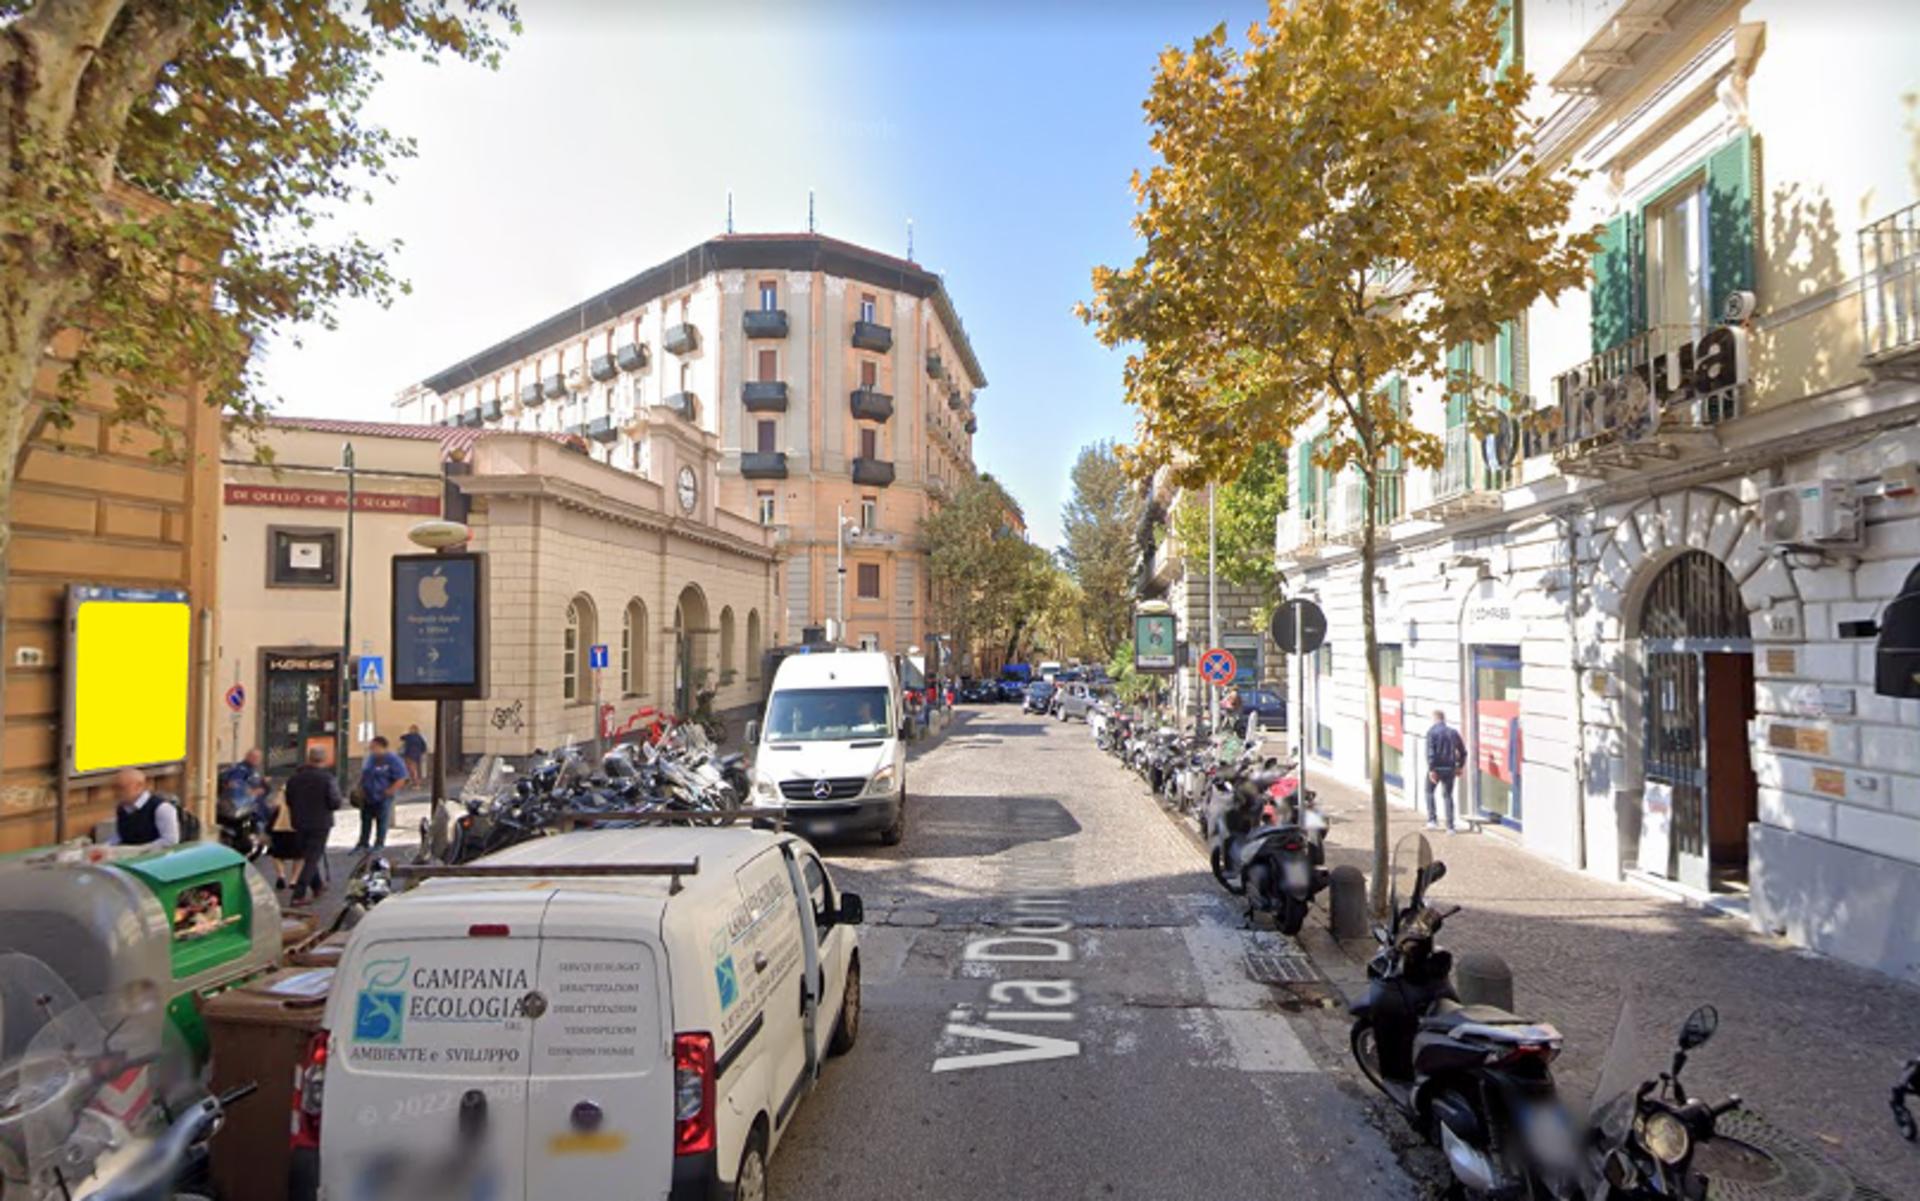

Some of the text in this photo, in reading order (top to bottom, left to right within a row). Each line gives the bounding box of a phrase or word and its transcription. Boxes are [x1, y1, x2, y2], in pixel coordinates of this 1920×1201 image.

[413, 968, 528, 989] CAMPANIA
[409, 995, 527, 1018] ECOLOGIA
[351, 1047, 427, 1061] AMBIENTE
[445, 1048, 520, 1062] SVILUPPO
